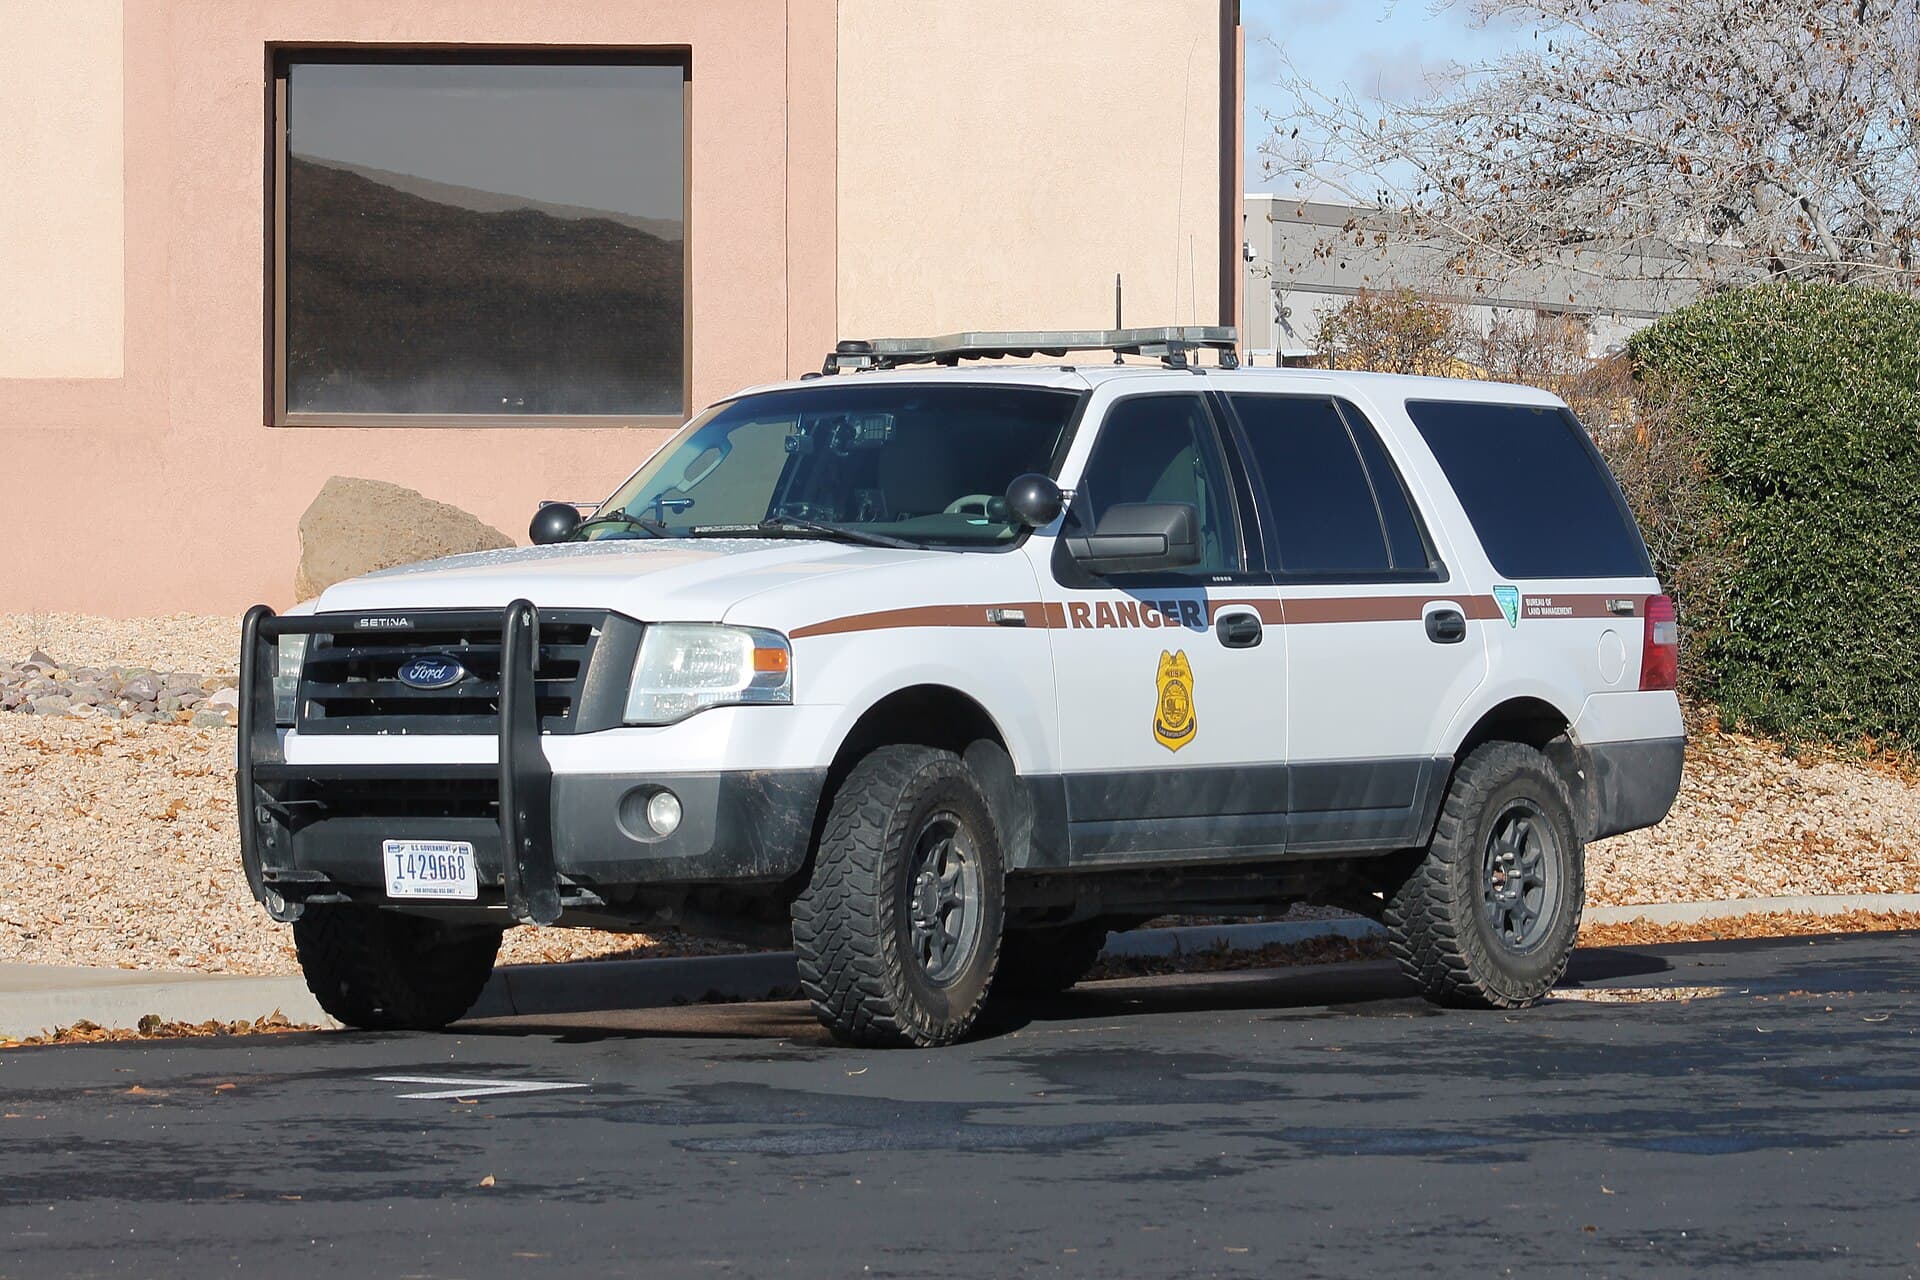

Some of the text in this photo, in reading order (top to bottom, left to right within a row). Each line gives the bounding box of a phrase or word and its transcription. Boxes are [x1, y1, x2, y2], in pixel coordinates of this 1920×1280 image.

[1525, 598, 1552, 606] BUREAU OF
[1068, 600, 1204, 628] RANGER
[1528, 607, 1573, 615] LAND MANAGEMENT
[360, 618, 408, 627] SETINA
[409, 660, 447, 680] Ford
[395, 854, 466, 880] I429668
